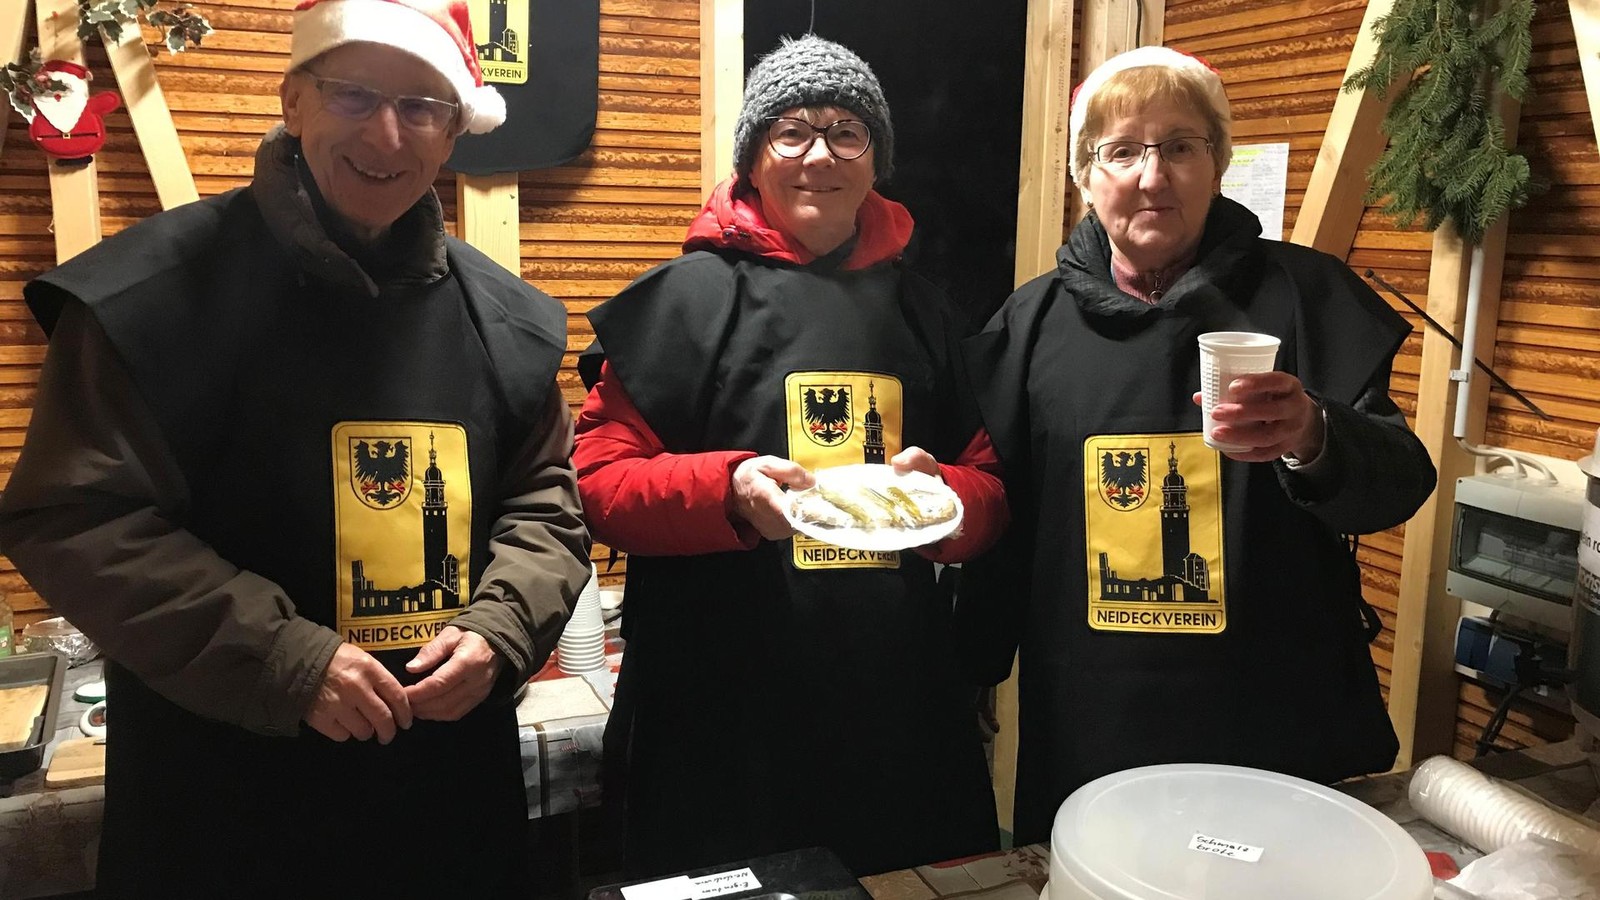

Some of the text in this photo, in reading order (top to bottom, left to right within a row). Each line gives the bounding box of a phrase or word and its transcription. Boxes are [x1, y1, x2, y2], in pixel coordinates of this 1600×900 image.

[481, 67, 522, 79] KVEREIN
[1097, 609, 1216, 626] NEIDECKVEREIN
[1196, 835, 1250, 852] Schmalz
